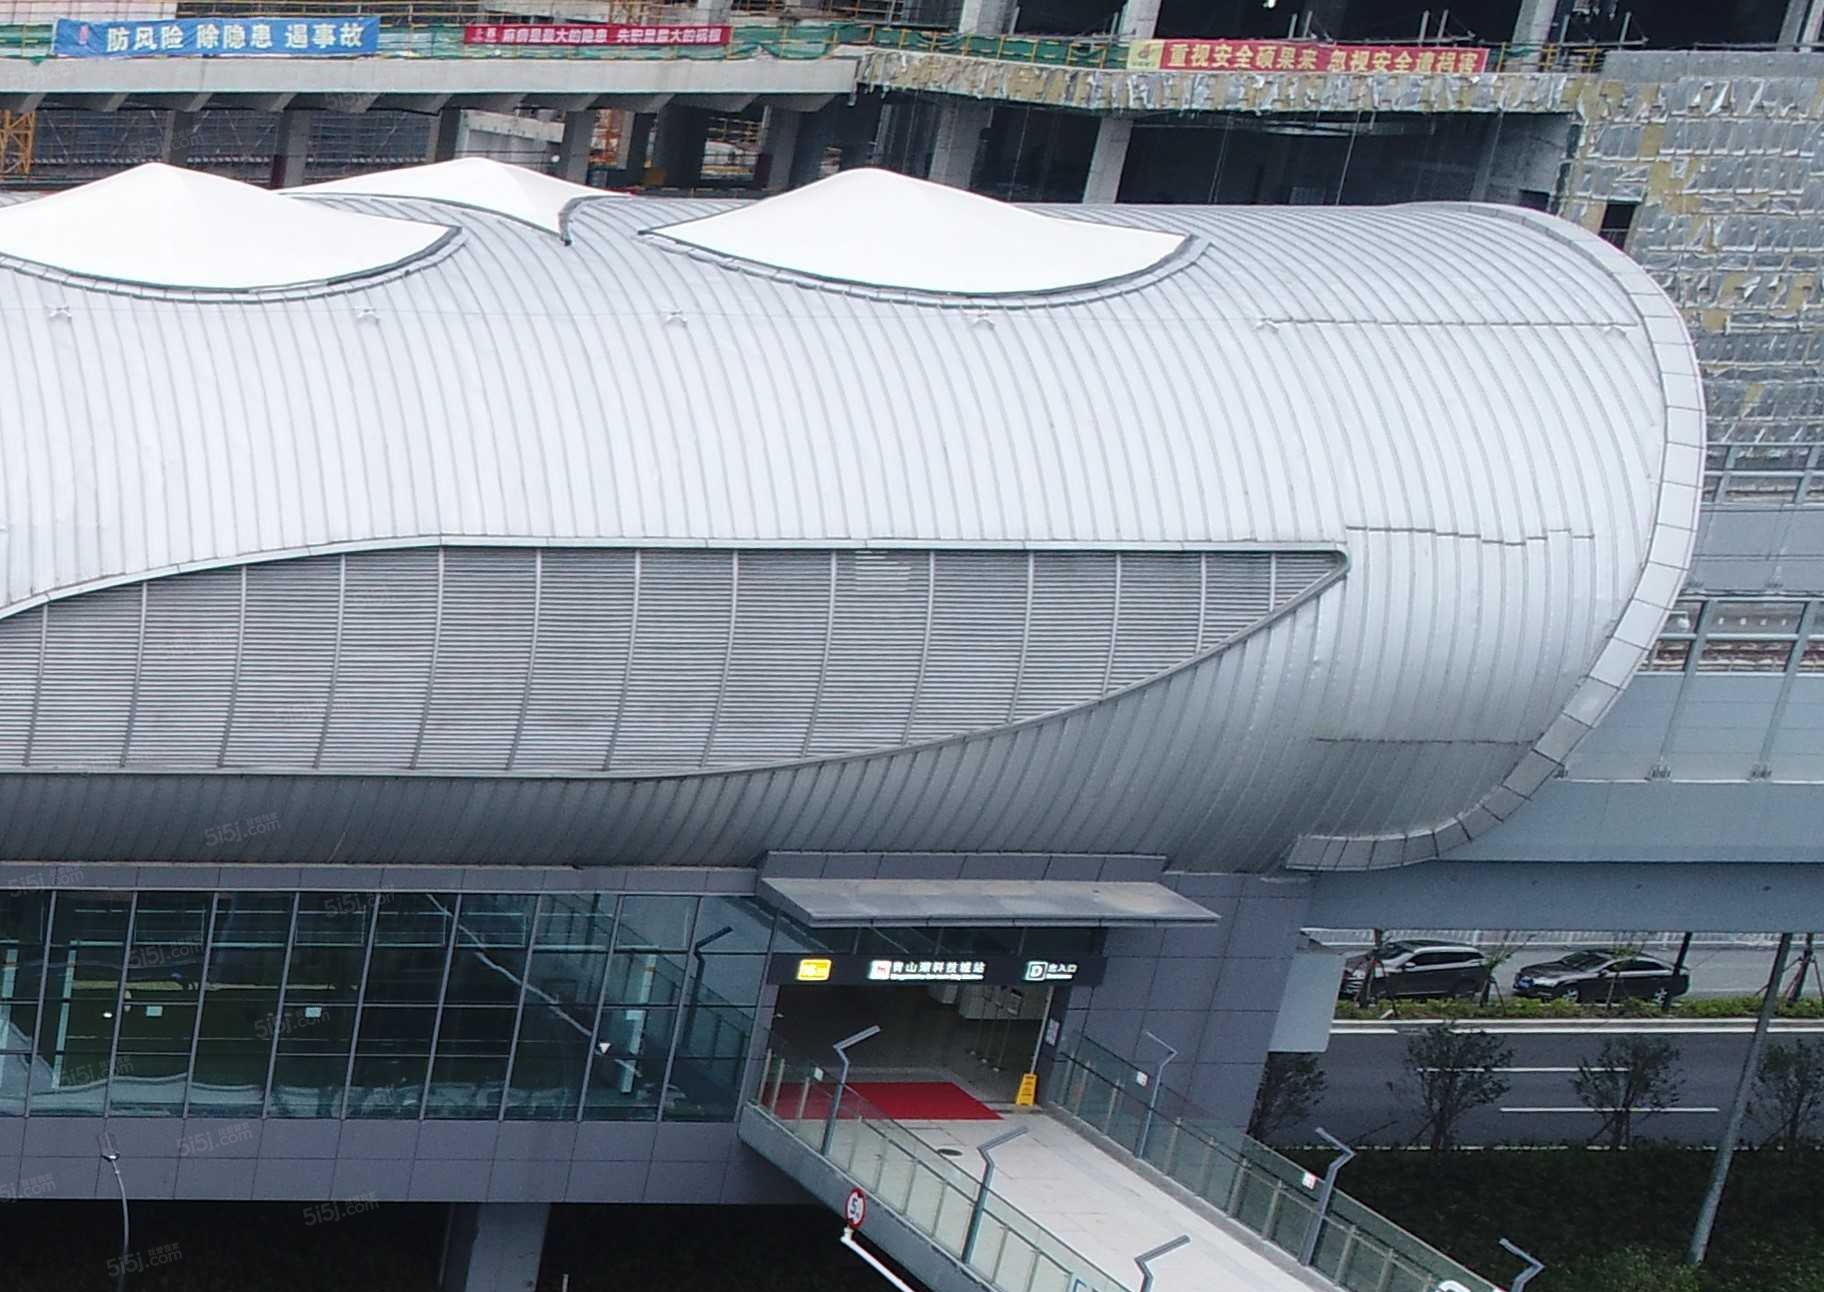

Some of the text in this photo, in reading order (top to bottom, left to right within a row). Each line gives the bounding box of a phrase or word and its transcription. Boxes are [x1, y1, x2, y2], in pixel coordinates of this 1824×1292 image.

[106, 26, 185, 52] 防风险
[196, 24, 273, 49] 除隐患
[1167, 43, 1319, 71] 重视安全硕果来
[891, 961, 986, 974] 青山湖科技城站
